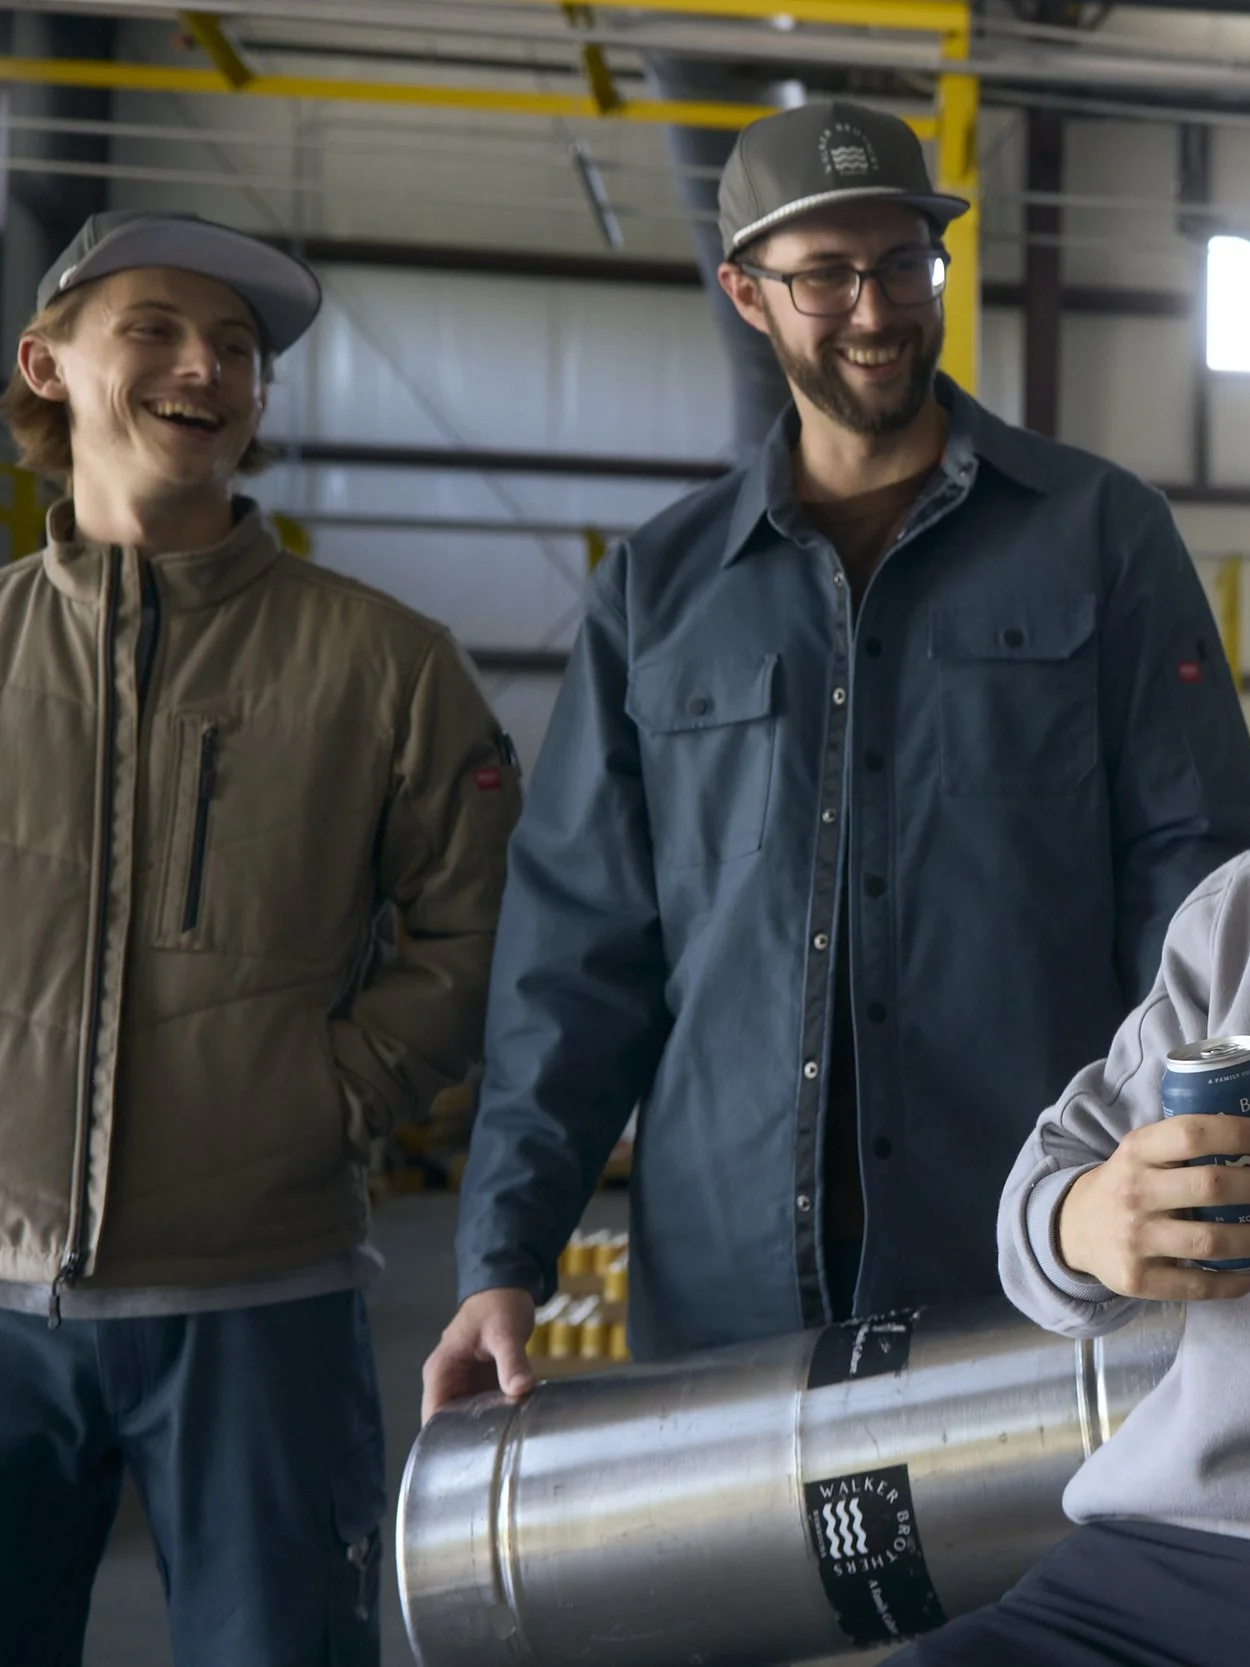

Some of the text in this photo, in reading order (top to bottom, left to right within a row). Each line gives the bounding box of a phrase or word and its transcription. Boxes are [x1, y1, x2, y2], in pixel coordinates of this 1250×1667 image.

[1215, 1074, 1240, 1084] FAMILY
[820, 1476, 911, 1577] WALKER BROTHERS
